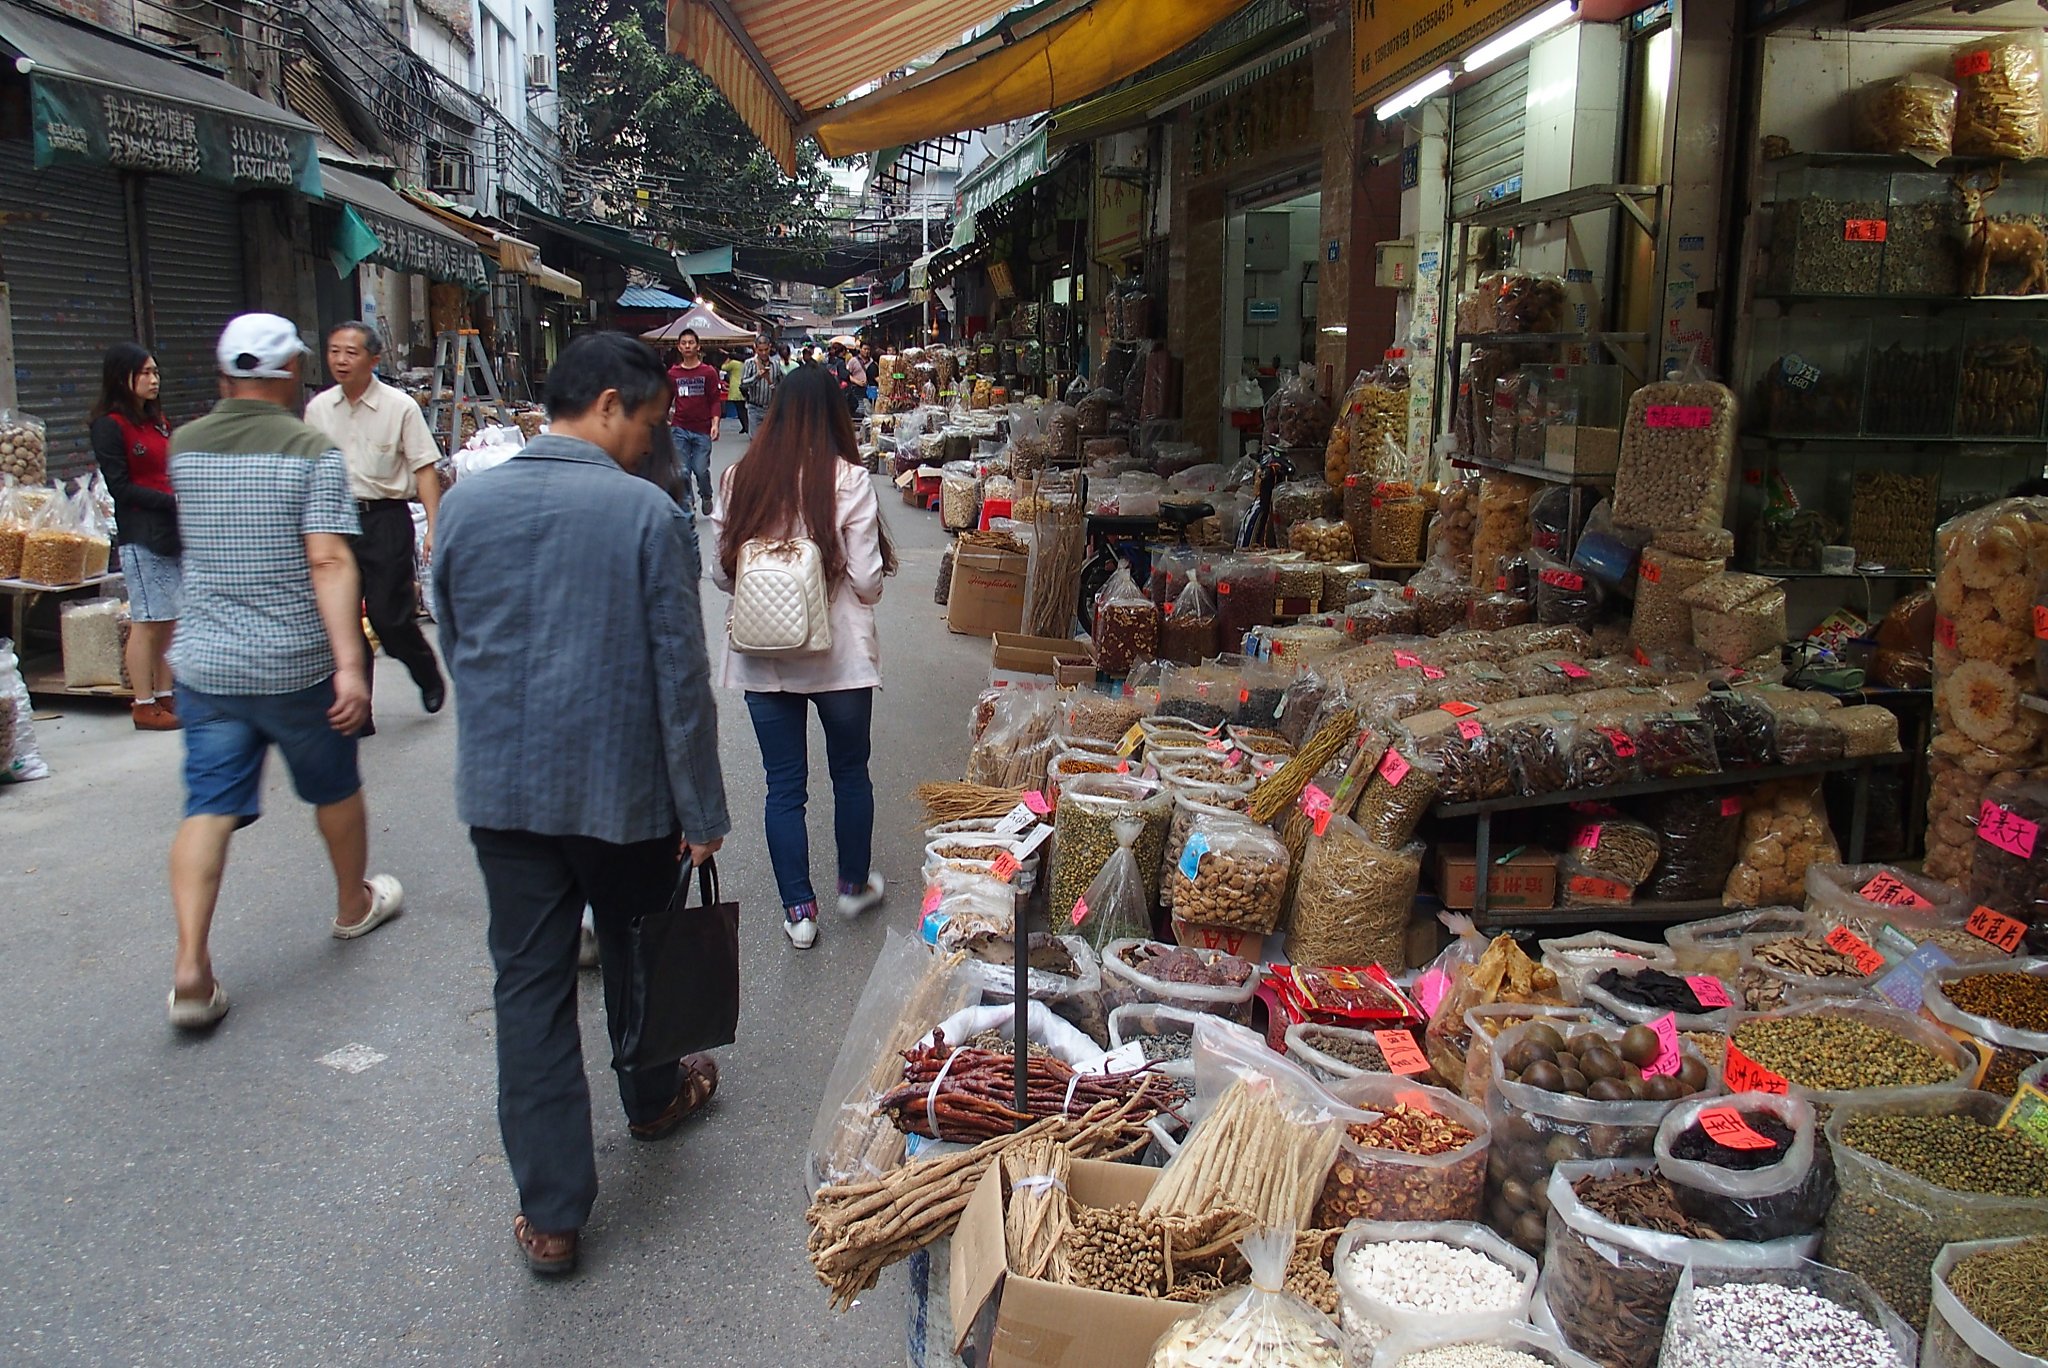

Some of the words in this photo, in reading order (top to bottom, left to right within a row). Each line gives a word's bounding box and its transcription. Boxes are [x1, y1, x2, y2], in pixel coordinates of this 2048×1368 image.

[103, 94, 198, 145] 我为宠物健康
[108, 131, 200, 175] 宠物给我精彩
[1977, 806, 2030, 854] 红景天
